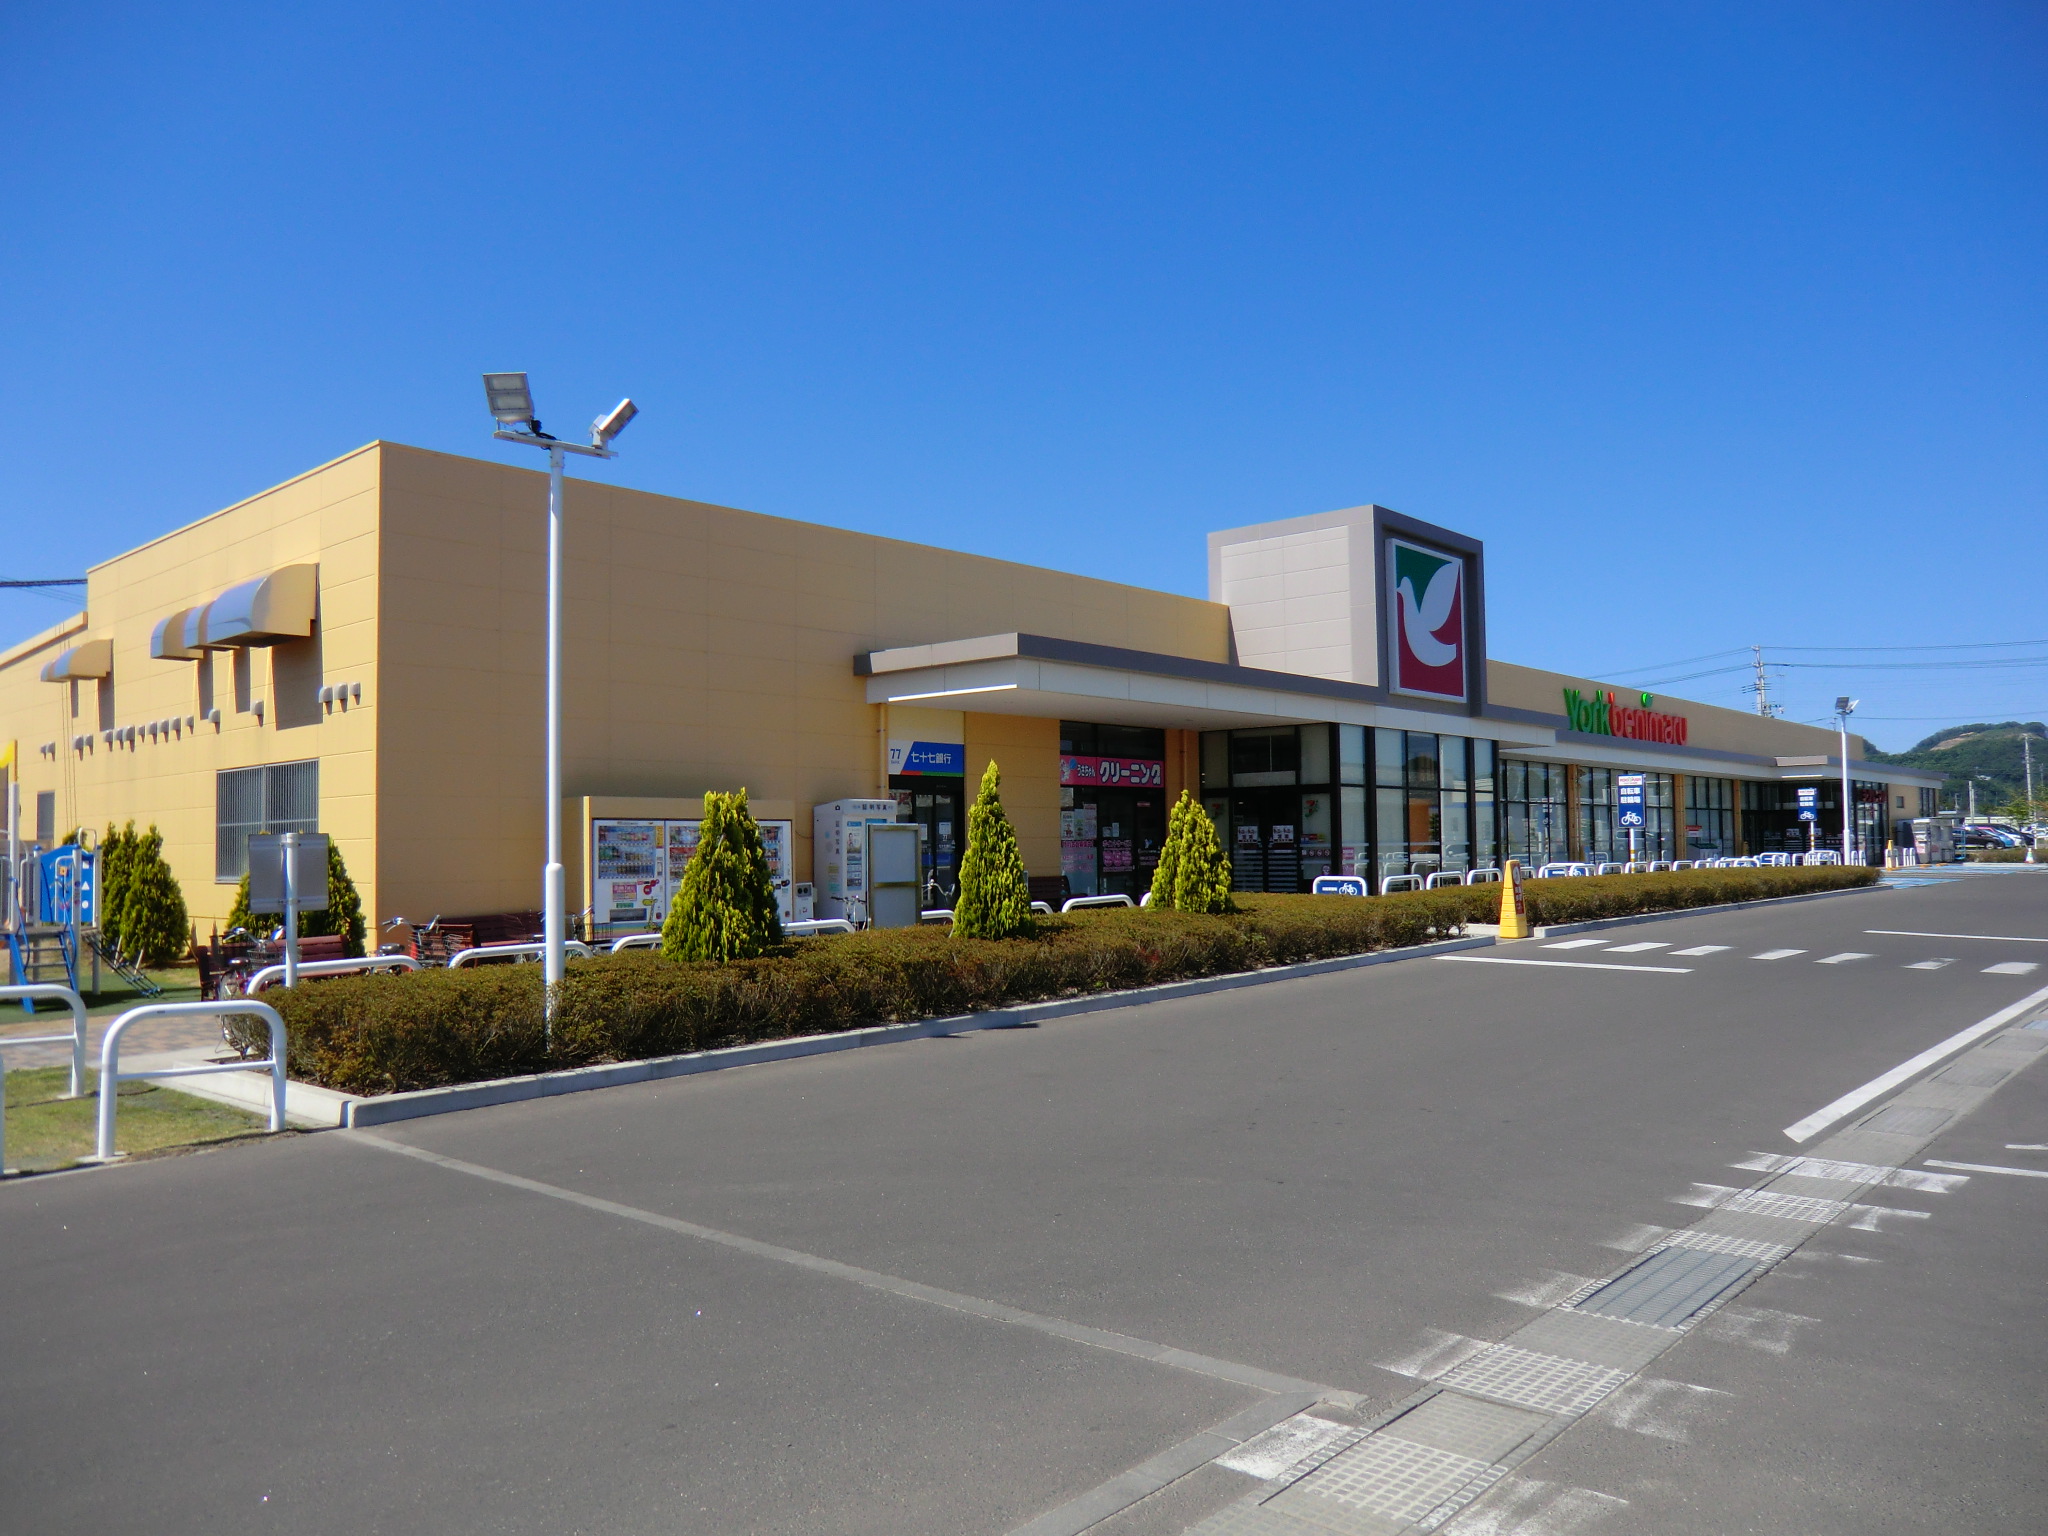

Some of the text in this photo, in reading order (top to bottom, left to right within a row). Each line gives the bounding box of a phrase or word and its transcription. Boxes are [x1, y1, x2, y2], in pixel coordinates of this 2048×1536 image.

[889, 748, 902, 760] 77
[910, 751, 952, 765] 七十七銀行
[1099, 760, 1161, 785] クリーニング
